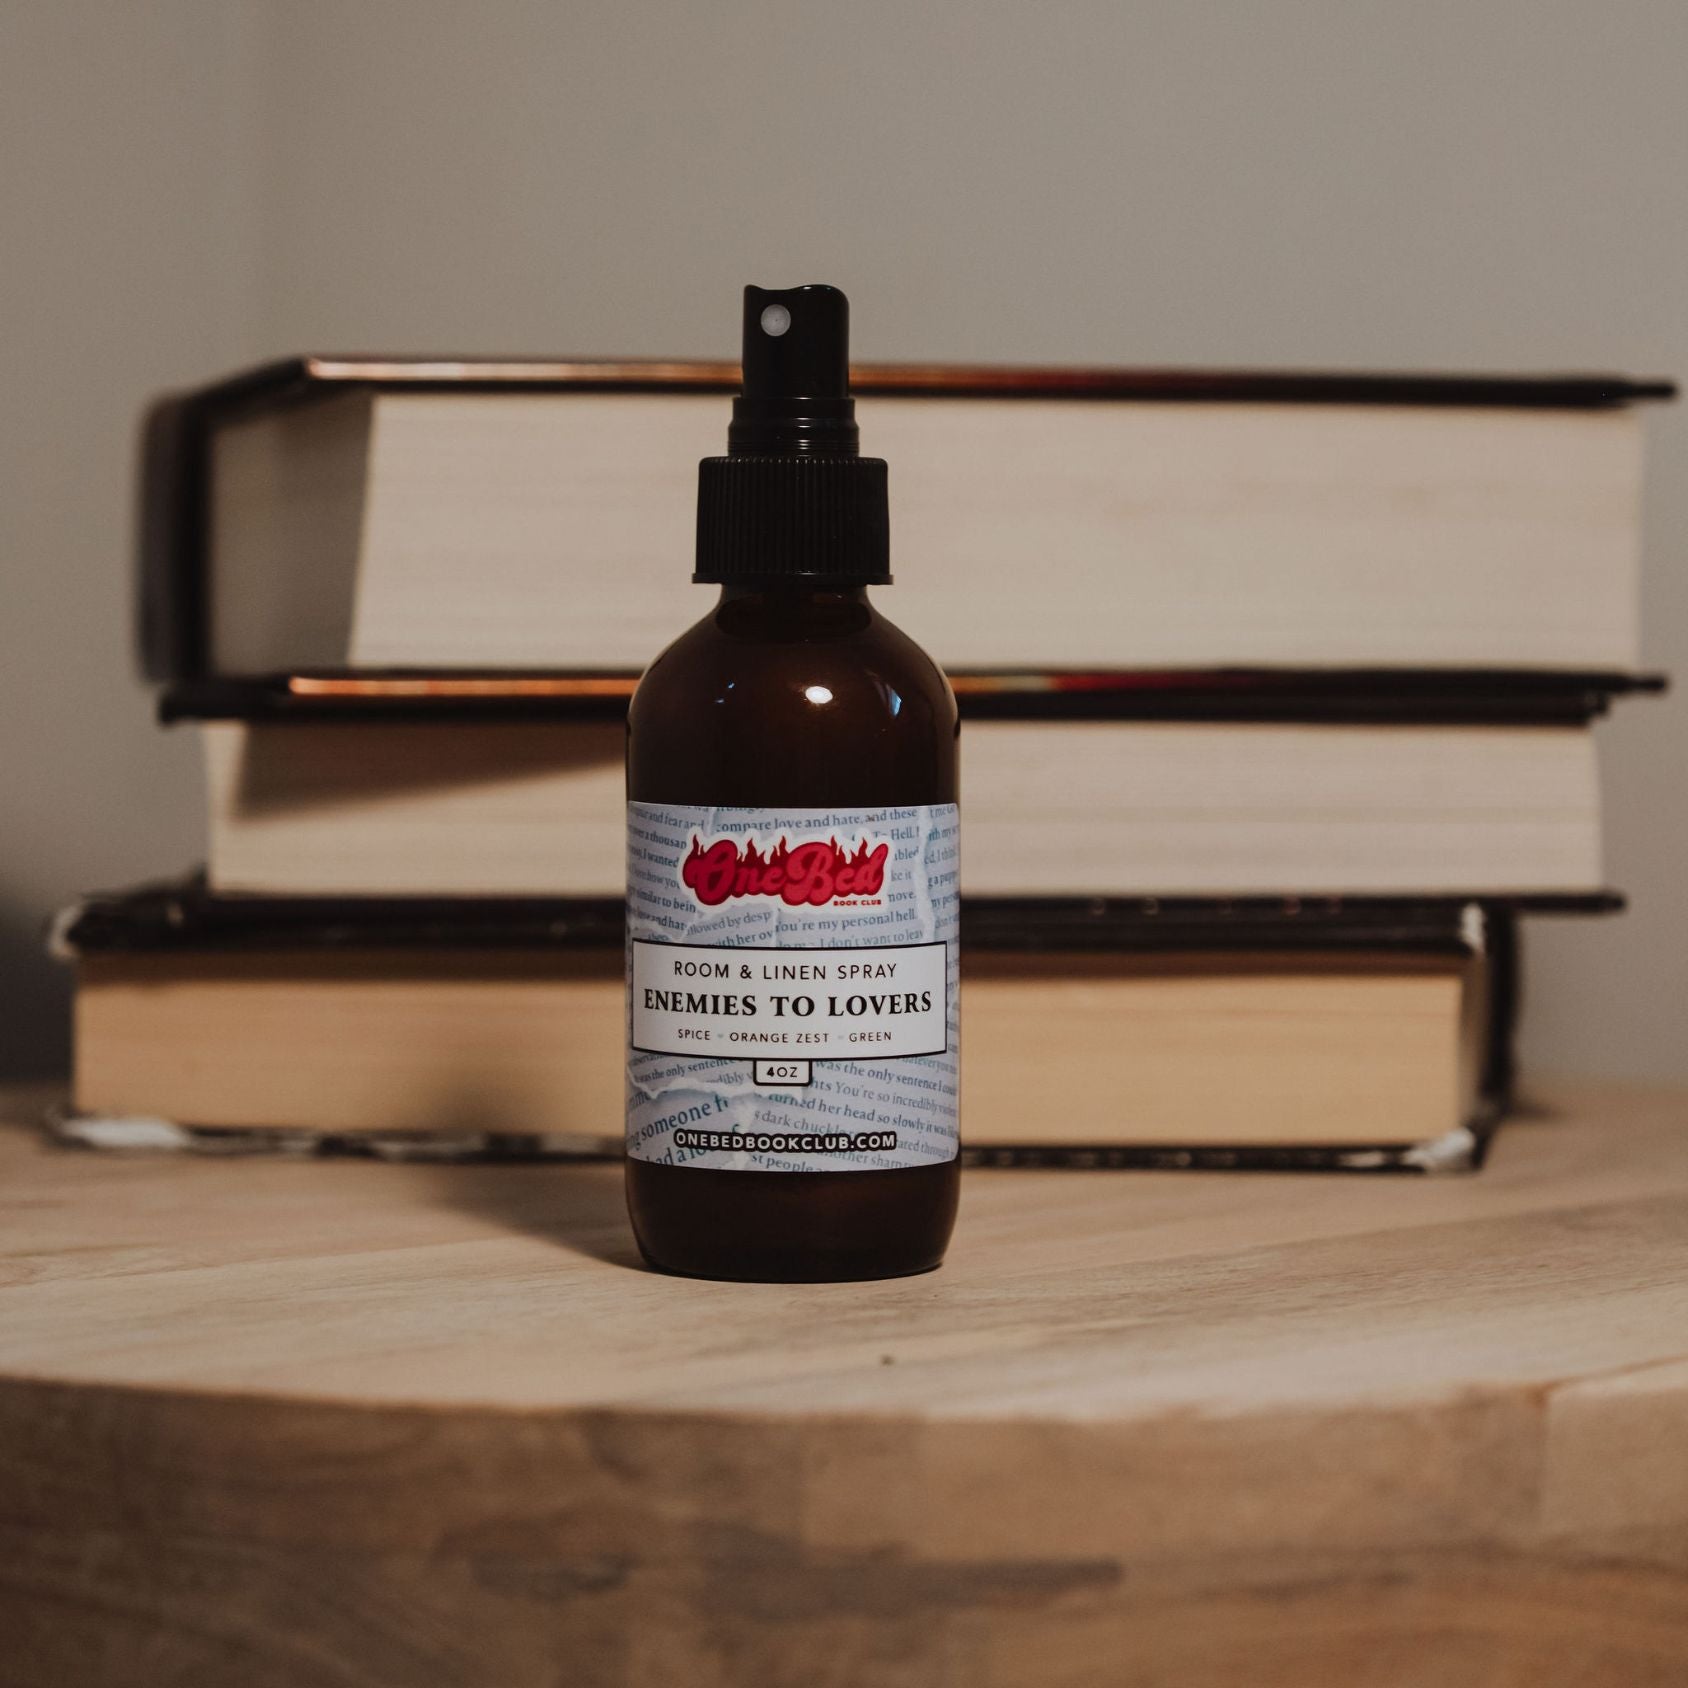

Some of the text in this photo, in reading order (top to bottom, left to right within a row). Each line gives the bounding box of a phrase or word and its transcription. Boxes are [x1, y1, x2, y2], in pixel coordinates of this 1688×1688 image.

[775, 817, 802, 829] love
[805, 815, 830, 828] and
[865, 809, 887, 823] and
[890, 807, 917, 820] these
[727, 915, 741, 929] by
[818, 920, 839, 931] my
[842, 911, 893, 931] personal
[736, 934, 756, 945] her
[862, 933, 891, 946] want
[893, 932, 904, 942] to
[674, 961, 897, 980] ROOM & LINEN SPRAY
[644, 988, 932, 1017] ENEMIES TO LOVERS
[677, 1028, 893, 1044] SPICE ORANGE ZEST GREEN
[666, 1063, 686, 1077] only
[816, 1060, 841, 1071] was
[844, 1062, 865, 1076] the
[867, 1068, 896, 1084] only
[896, 1074, 938, 1091] sentence
[836, 1082, 874, 1099] You're
[877, 1092, 890, 1102] so
[641, 1102, 712, 1141] someone
[762, 1110, 791, 1127] dark
[818, 1099, 842, 1115] her
[844, 1104, 876, 1122] head
[877, 1115, 890, 1124] so
[893, 1114, 926, 1133] slowly
[676, 1132, 895, 1150] ONEBEDBOOKCLUB.COM
[817, 1150, 868, 1165] other
